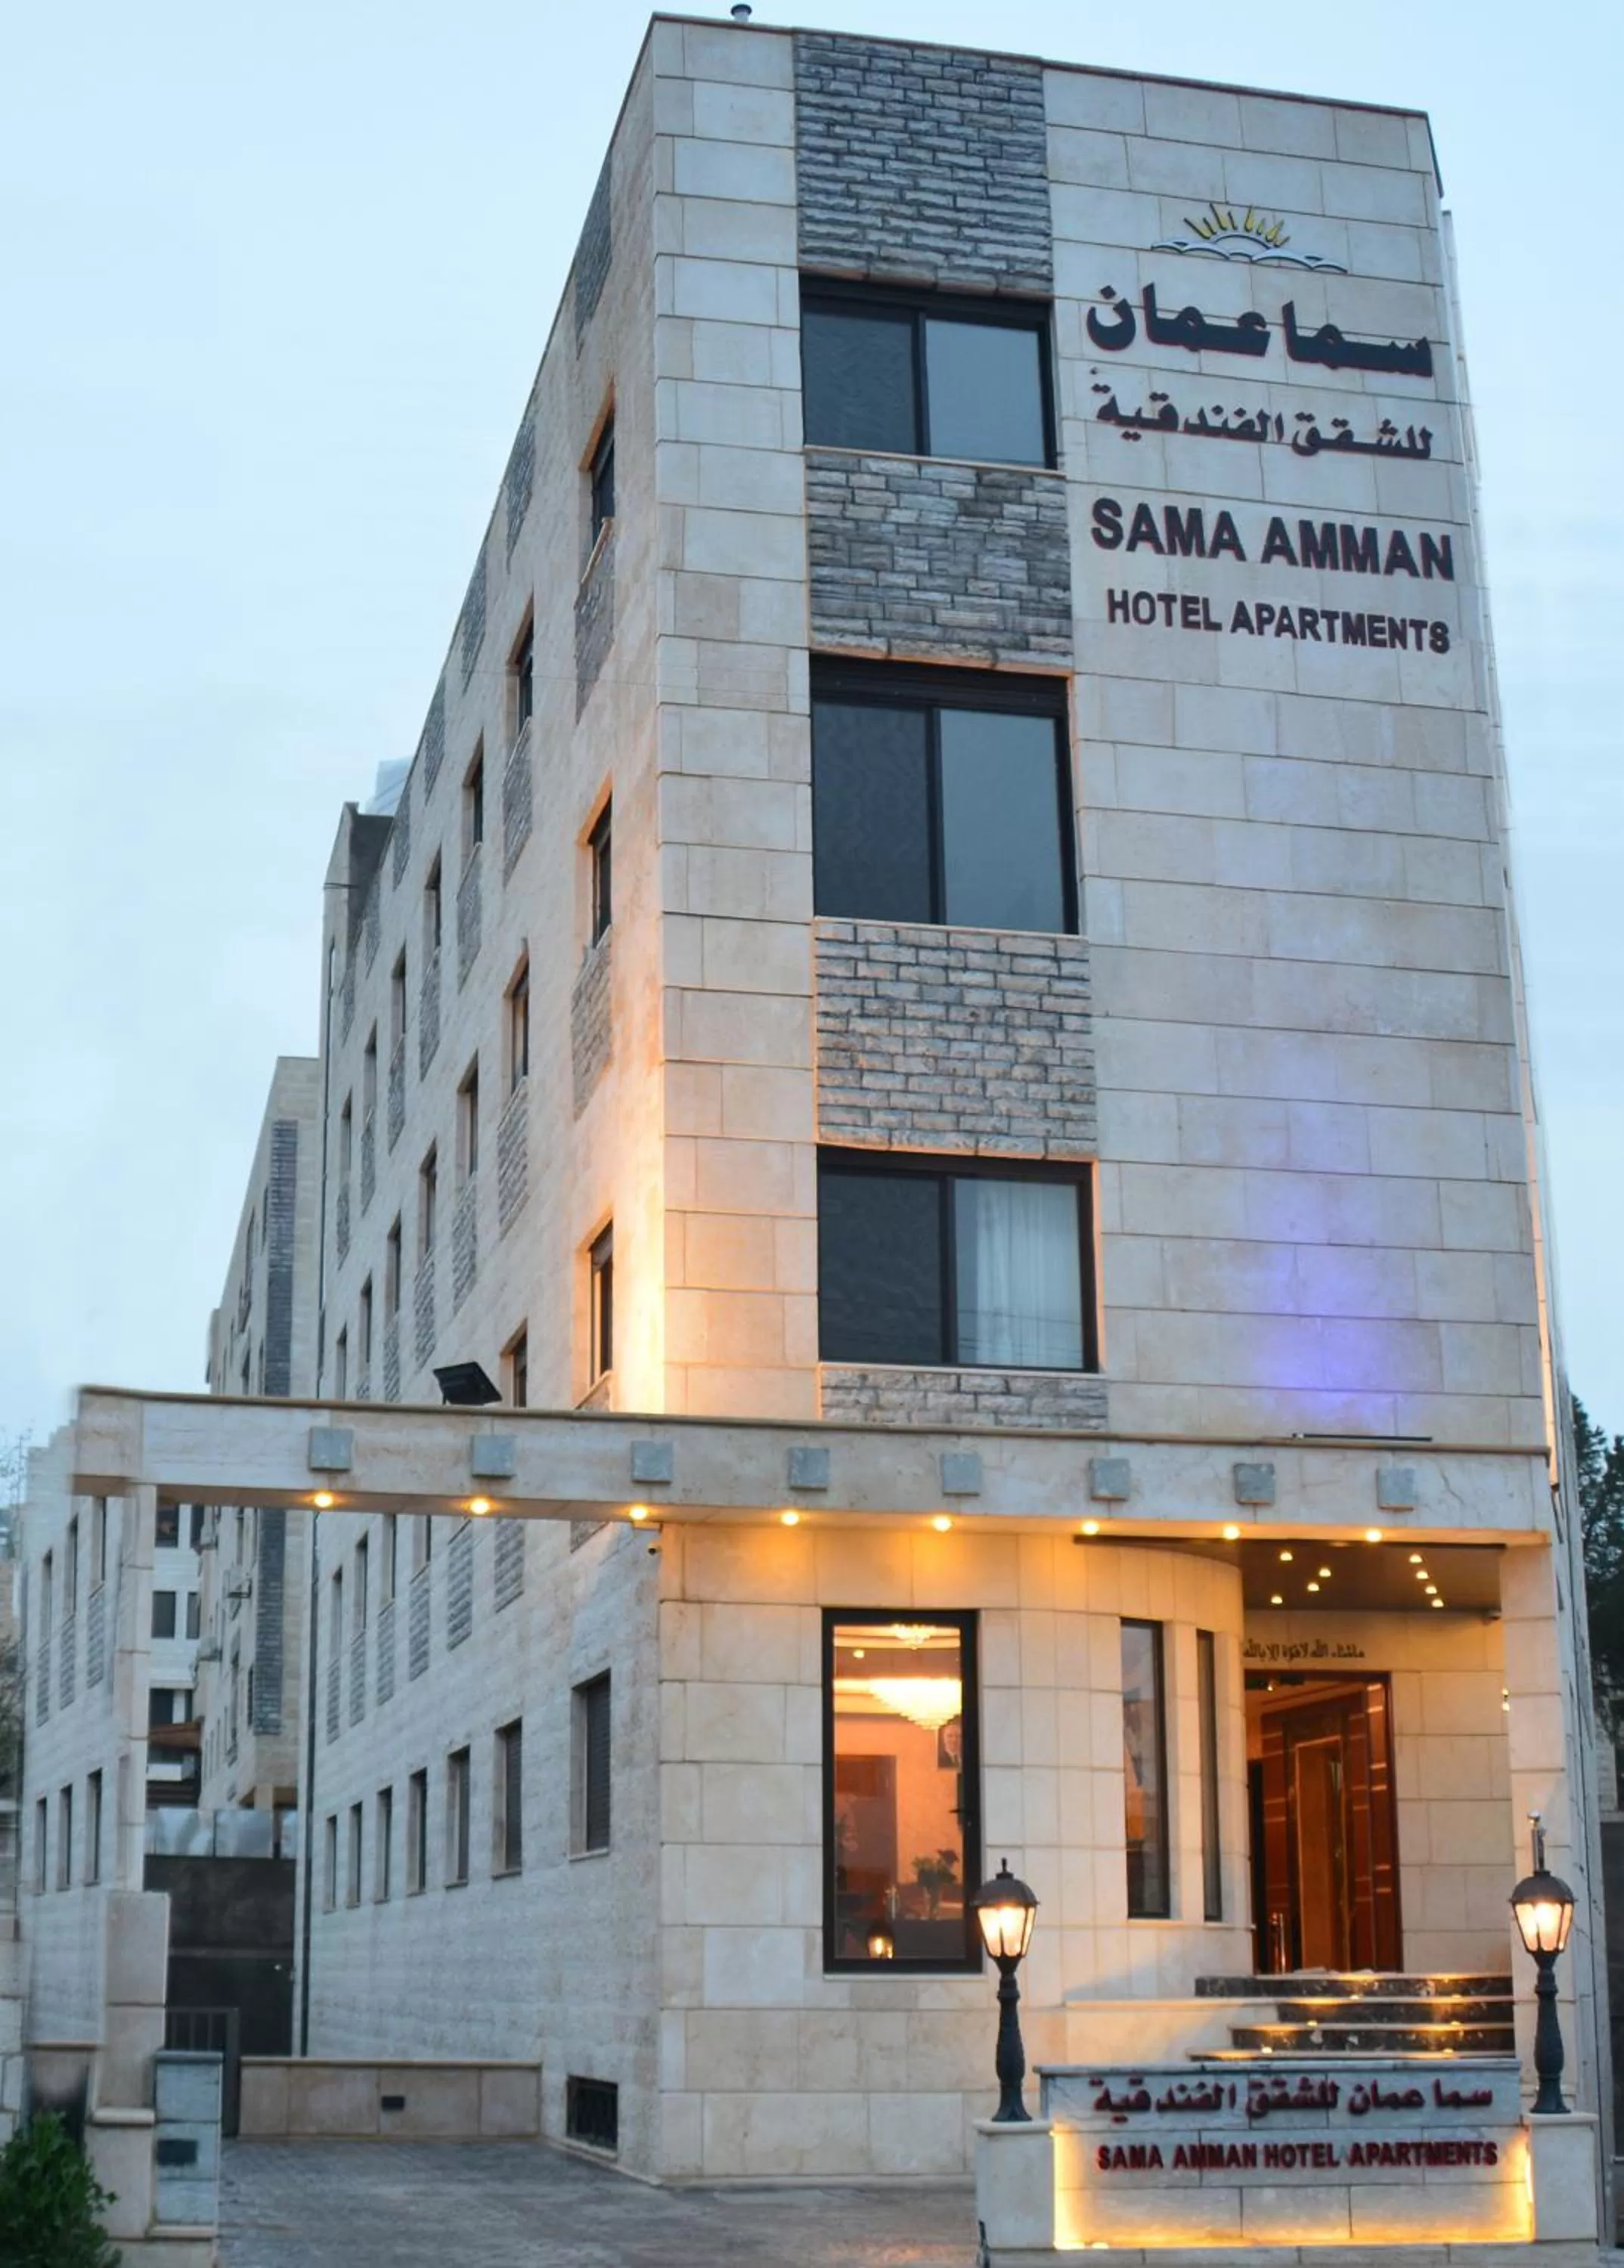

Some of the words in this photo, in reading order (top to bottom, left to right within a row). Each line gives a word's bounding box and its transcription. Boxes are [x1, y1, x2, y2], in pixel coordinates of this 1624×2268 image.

[1086, 282, 1271, 358] عمان
[1282, 300, 1433, 378] سما
[1091, 383, 1285, 442] الفندقية
[1291, 411, 1433, 460] للشقق
[1091, 497, 1247, 562] SAMA
[1261, 516, 1455, 581] AMMAN
[1107, 588, 1223, 632] HOTEL
[1231, 601, 1450, 654] APARTMENTS
[1088, 2077, 1237, 2124] الفندقية
[1245, 2076, 1340, 2119] للشقق
[1347, 2078, 1426, 2116] عمان
[1433, 2078, 1493, 2108] سما
[1097, 2144, 1164, 2170] SAMA
[1173, 2143, 1257, 2169] AMMAN
[1264, 2143, 1340, 2168] HOTEL
[1348, 2140, 1498, 2167] APARTMENTS
